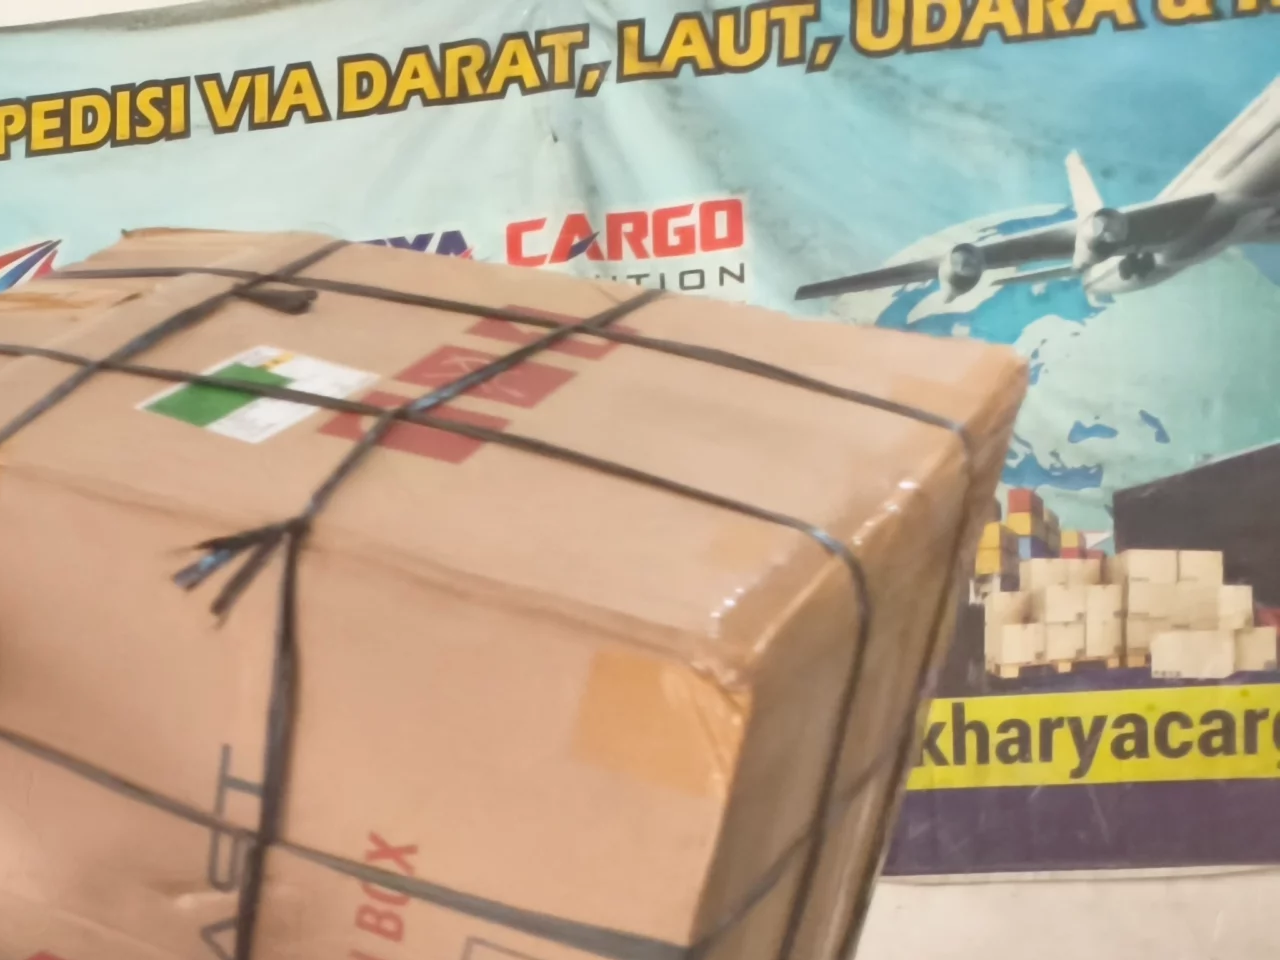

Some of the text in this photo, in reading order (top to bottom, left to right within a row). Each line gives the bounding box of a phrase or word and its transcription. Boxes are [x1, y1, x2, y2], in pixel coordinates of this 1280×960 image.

[198, 61, 331, 134] VIA
[336, 24, 611, 119] DARAT,
[616, 2, 844, 81] LAUT,
[505, 198, 745, 267] CARGO
